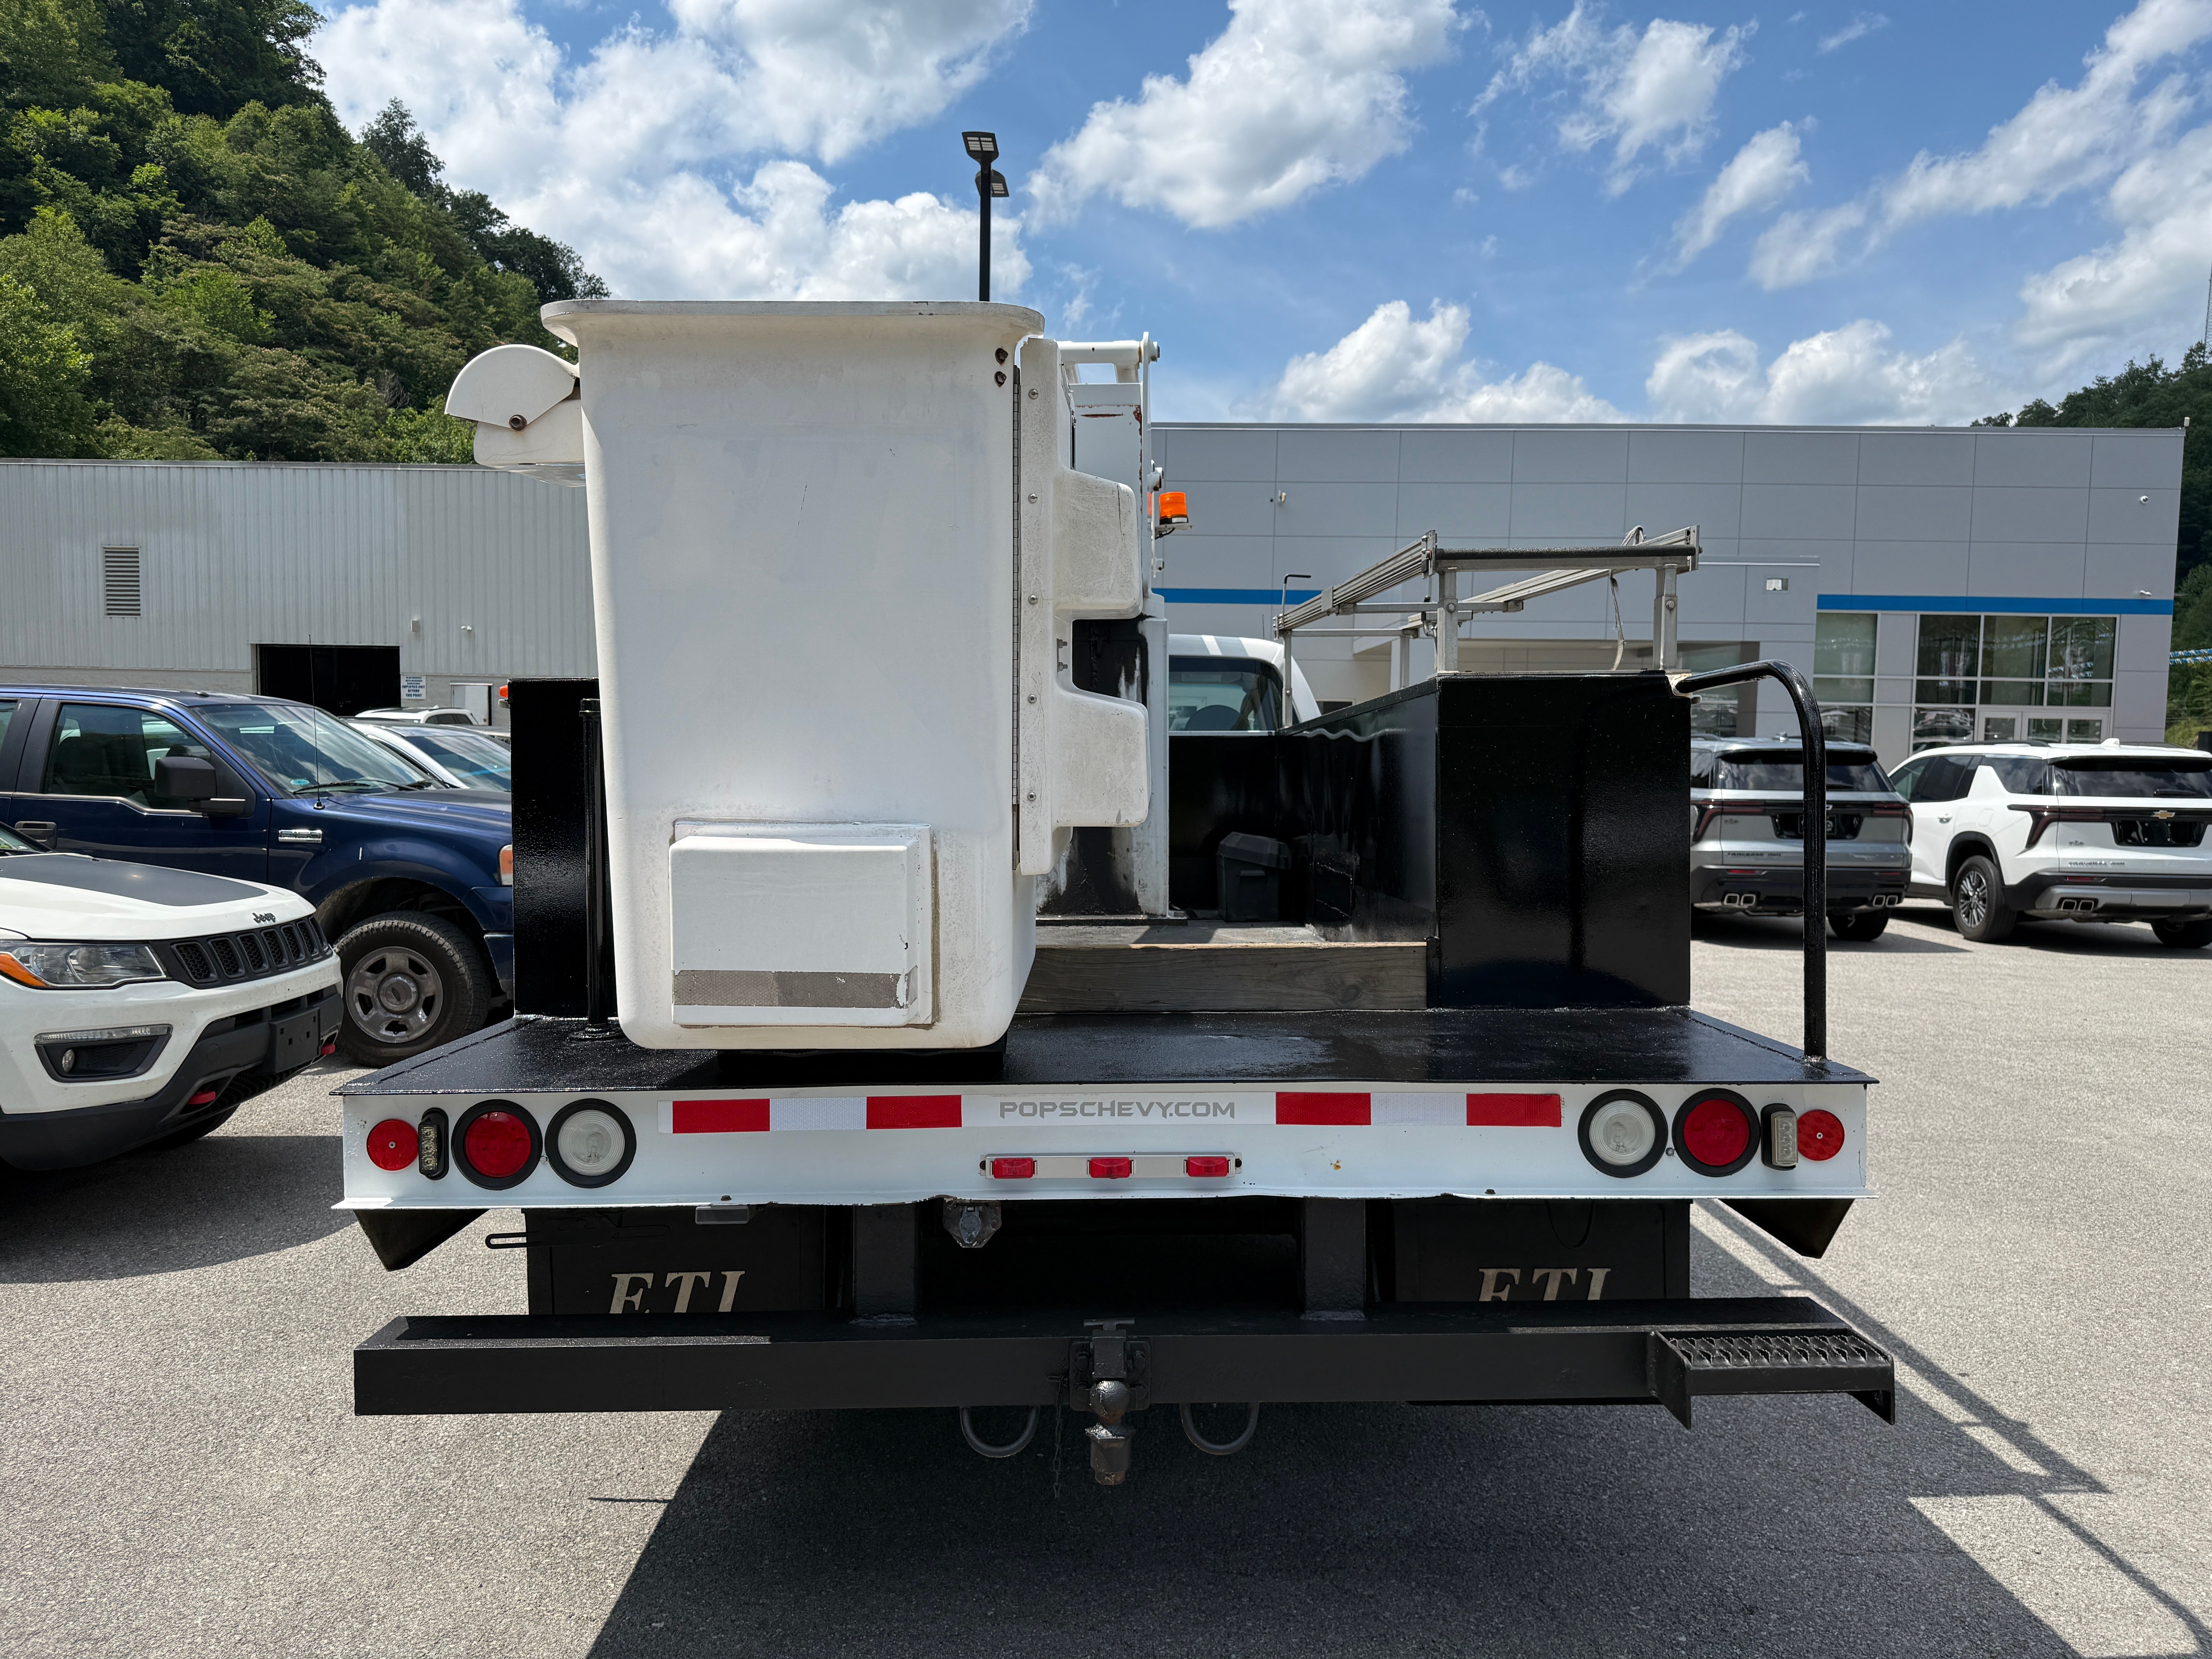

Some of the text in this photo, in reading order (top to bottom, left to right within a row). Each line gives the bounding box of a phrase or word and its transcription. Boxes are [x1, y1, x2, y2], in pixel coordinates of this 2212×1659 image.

[252, 912, 276, 923] Jeep
[1000, 1100, 1235, 1119] POPSCHEVY.COM
[609, 1271, 745, 1314] ETI
